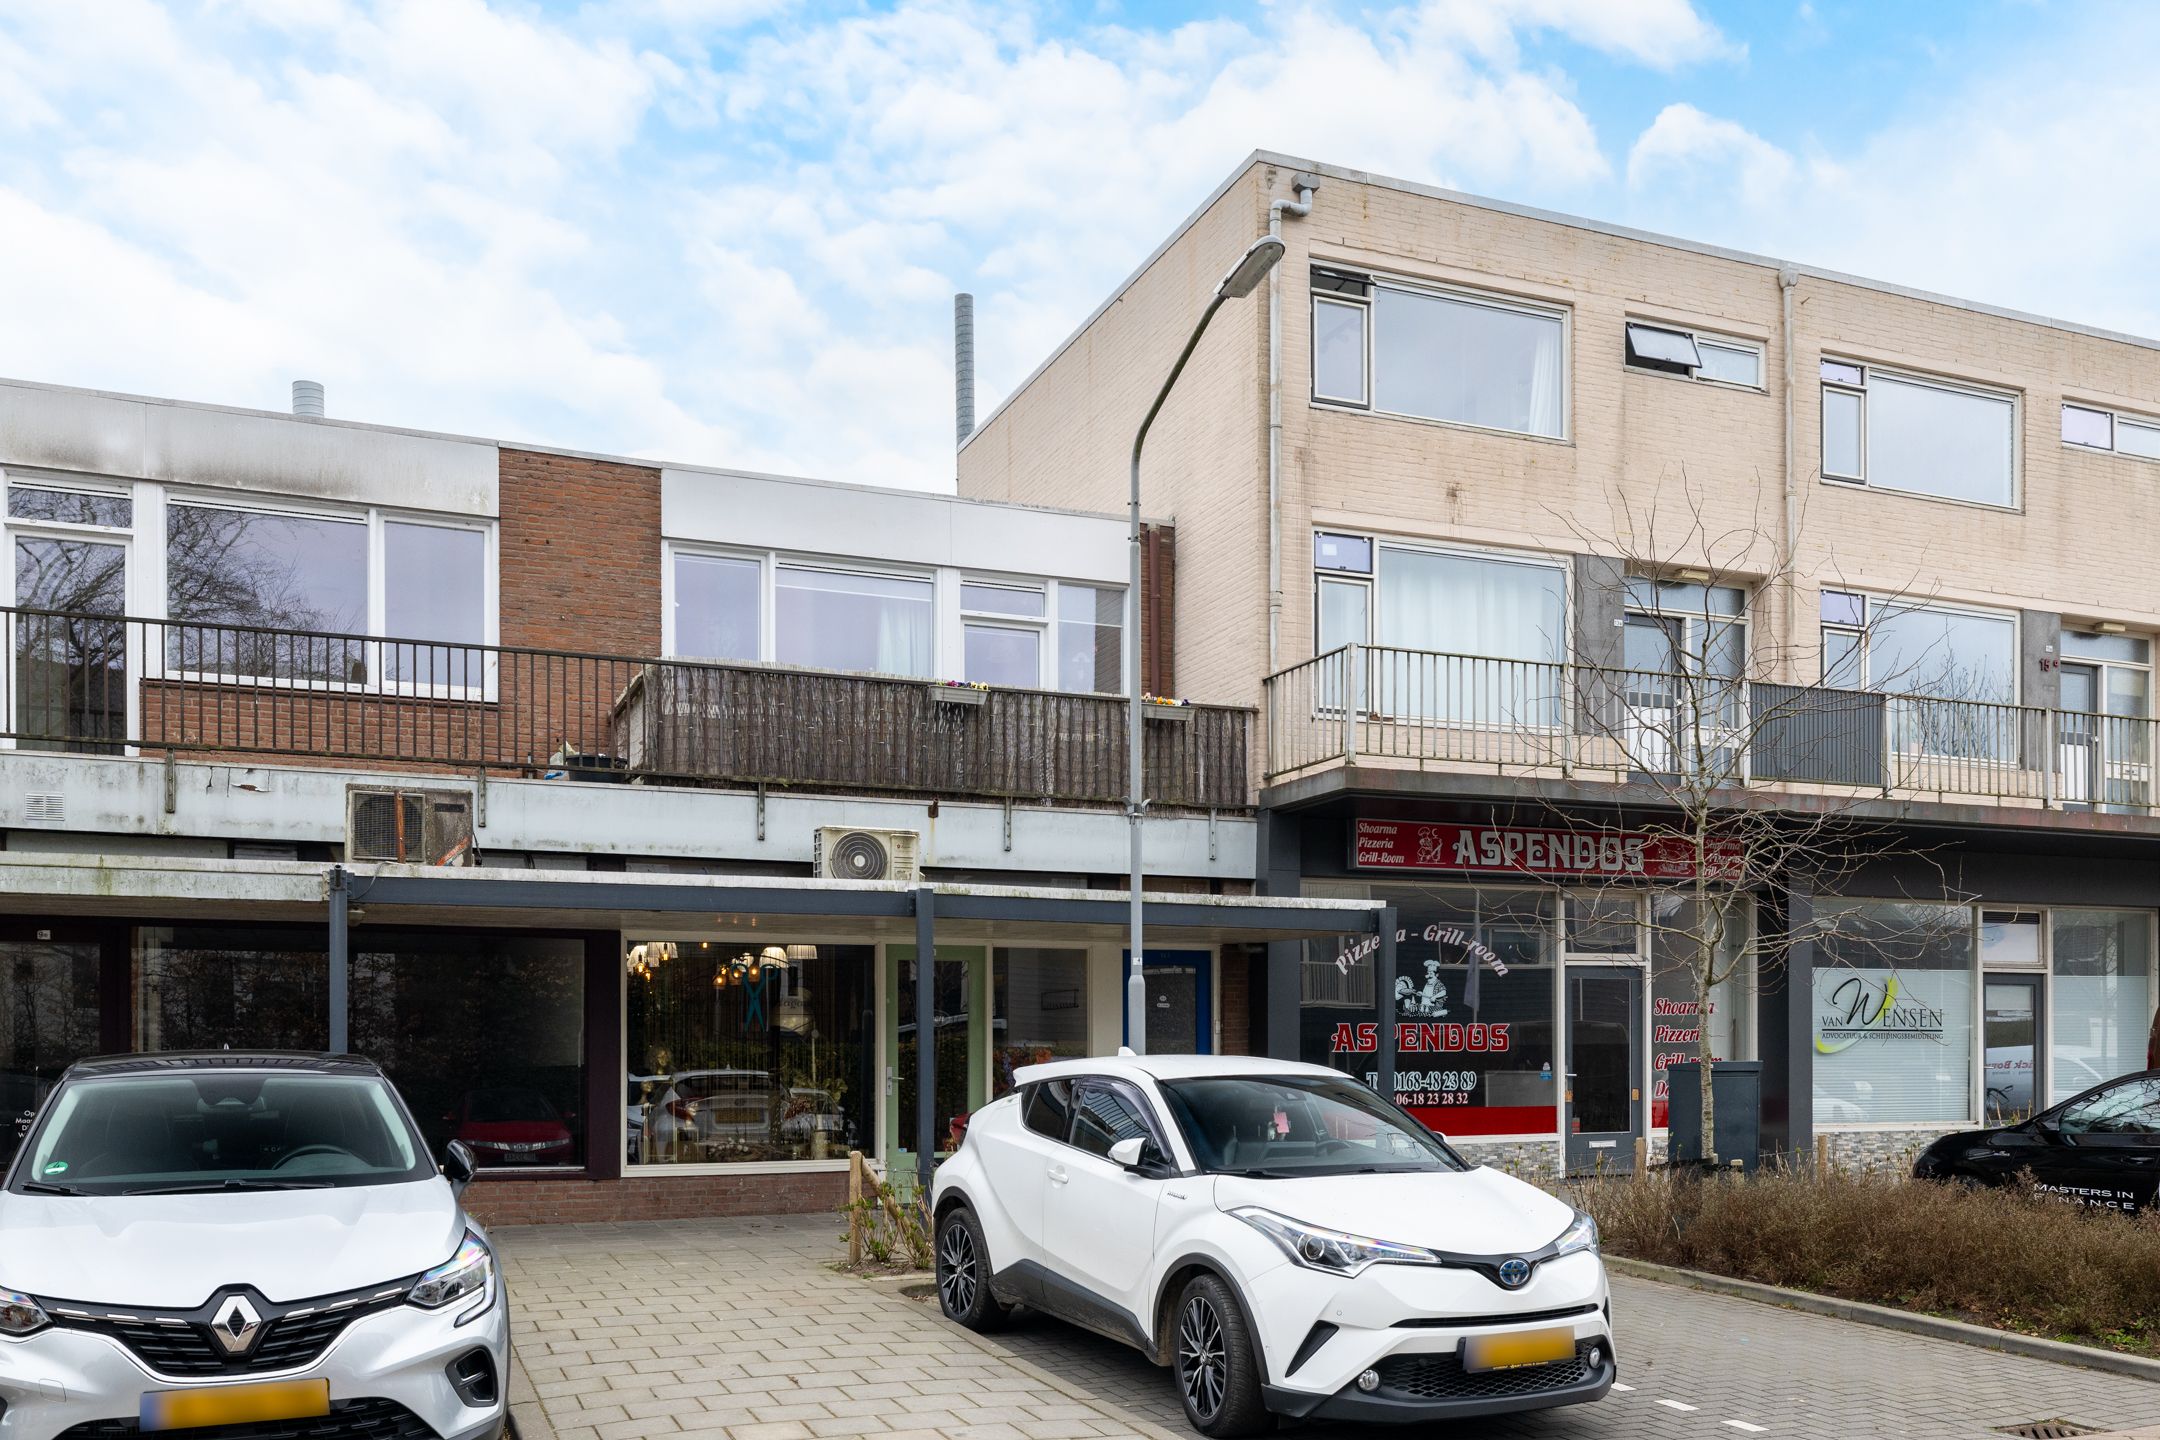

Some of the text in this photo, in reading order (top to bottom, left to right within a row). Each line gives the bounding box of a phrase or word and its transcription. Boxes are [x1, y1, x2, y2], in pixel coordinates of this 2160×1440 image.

[1358, 822, 1397, 834] Shoarma
[1359, 838, 1393, 849] Pizzeria
[1452, 830, 1645, 872] ASPENDOS
[1359, 852, 1405, 863] Grill-Room
[1335, 929, 1406, 976] Pizzea
[1423, 924, 1509, 977] Grill-room
[1654, 998, 1714, 1016] Shoara
[1822, 977, 1943, 1028] VAN WENSEN
[1654, 1024, 1700, 1043] Pizzeri
[1442, 1071, 1459, 1091] 23
[1460, 1071, 1477, 1091] 89
[1427, 1092, 1439, 1105] 23
[1442, 1092, 1454, 1105] 28
[1456, 1092, 1469, 1104] 32
[2034, 1183, 2134, 1199] MASTERS IN
[2034, 1193, 2135, 1210] FNANCE
